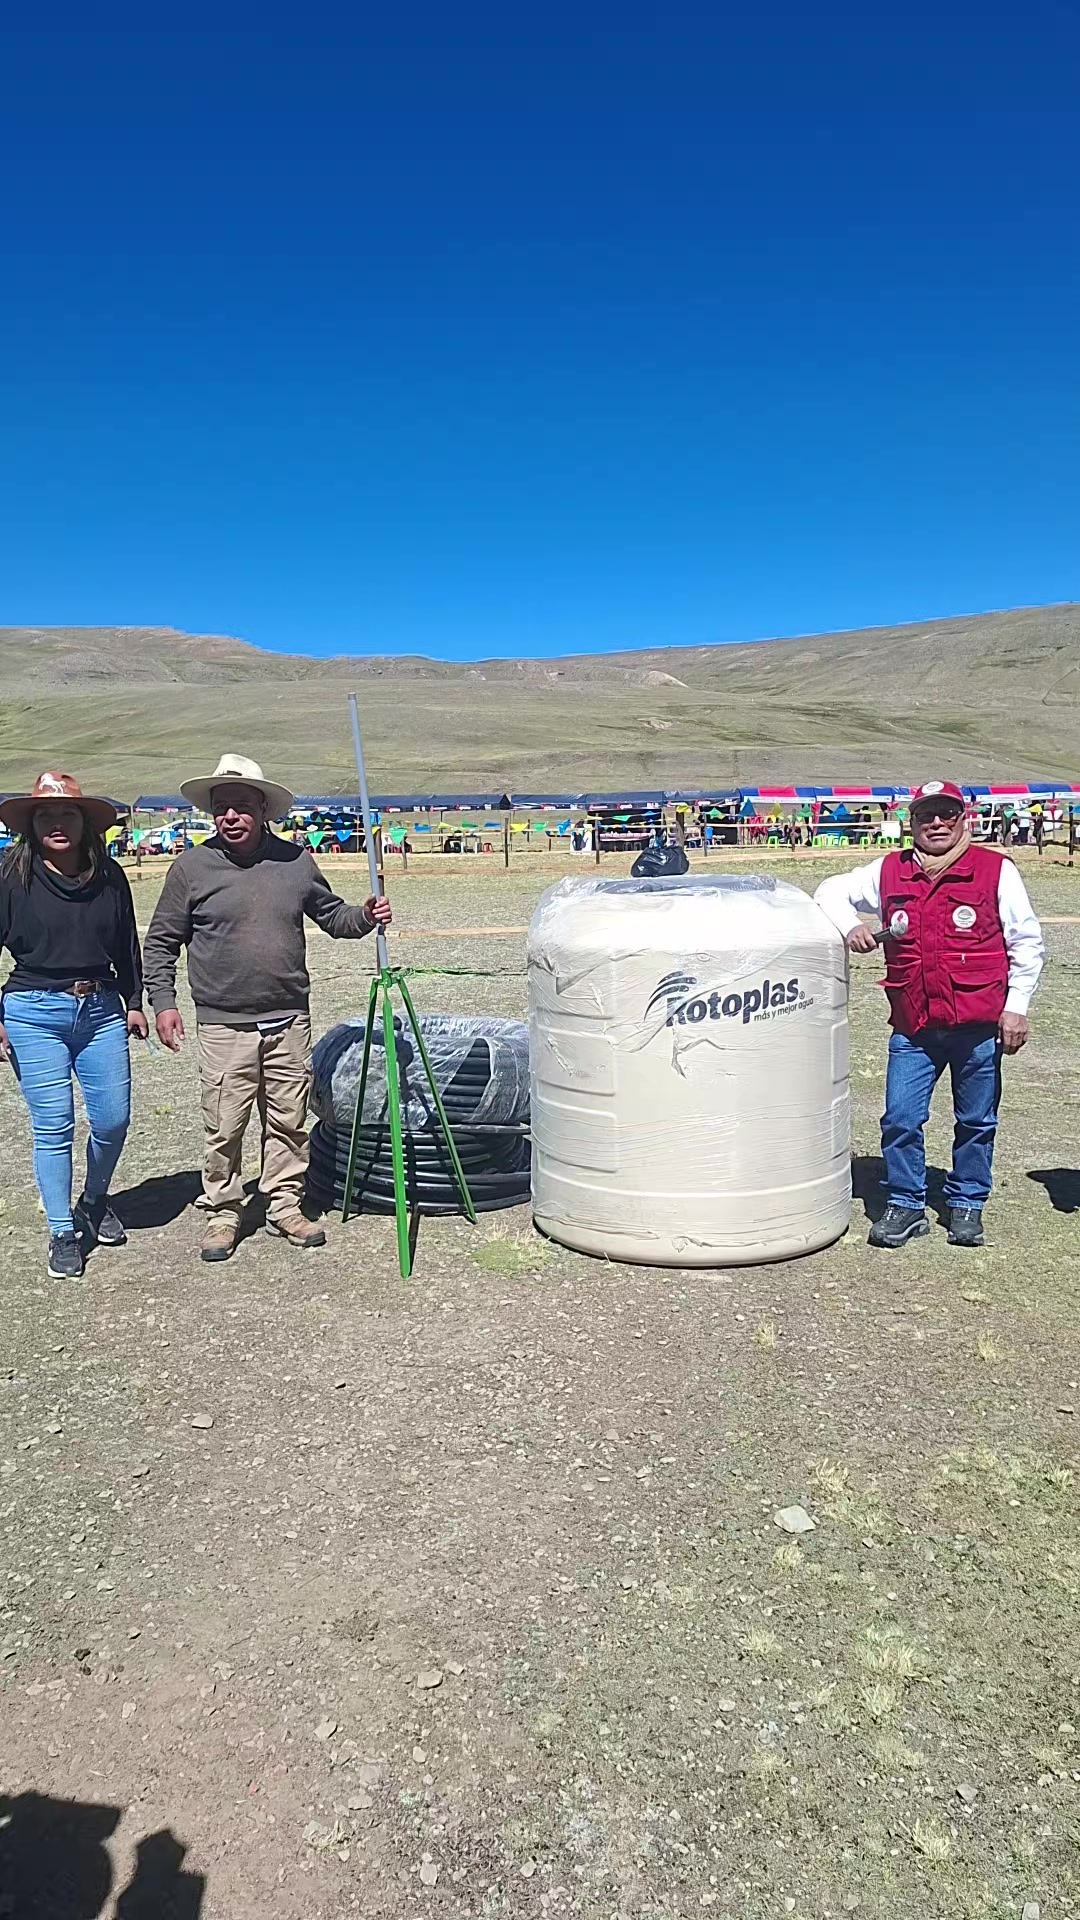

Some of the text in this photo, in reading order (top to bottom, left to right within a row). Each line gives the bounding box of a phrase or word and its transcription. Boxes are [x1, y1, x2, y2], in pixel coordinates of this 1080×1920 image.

[753, 998, 814, 1021] más y mejor agua
